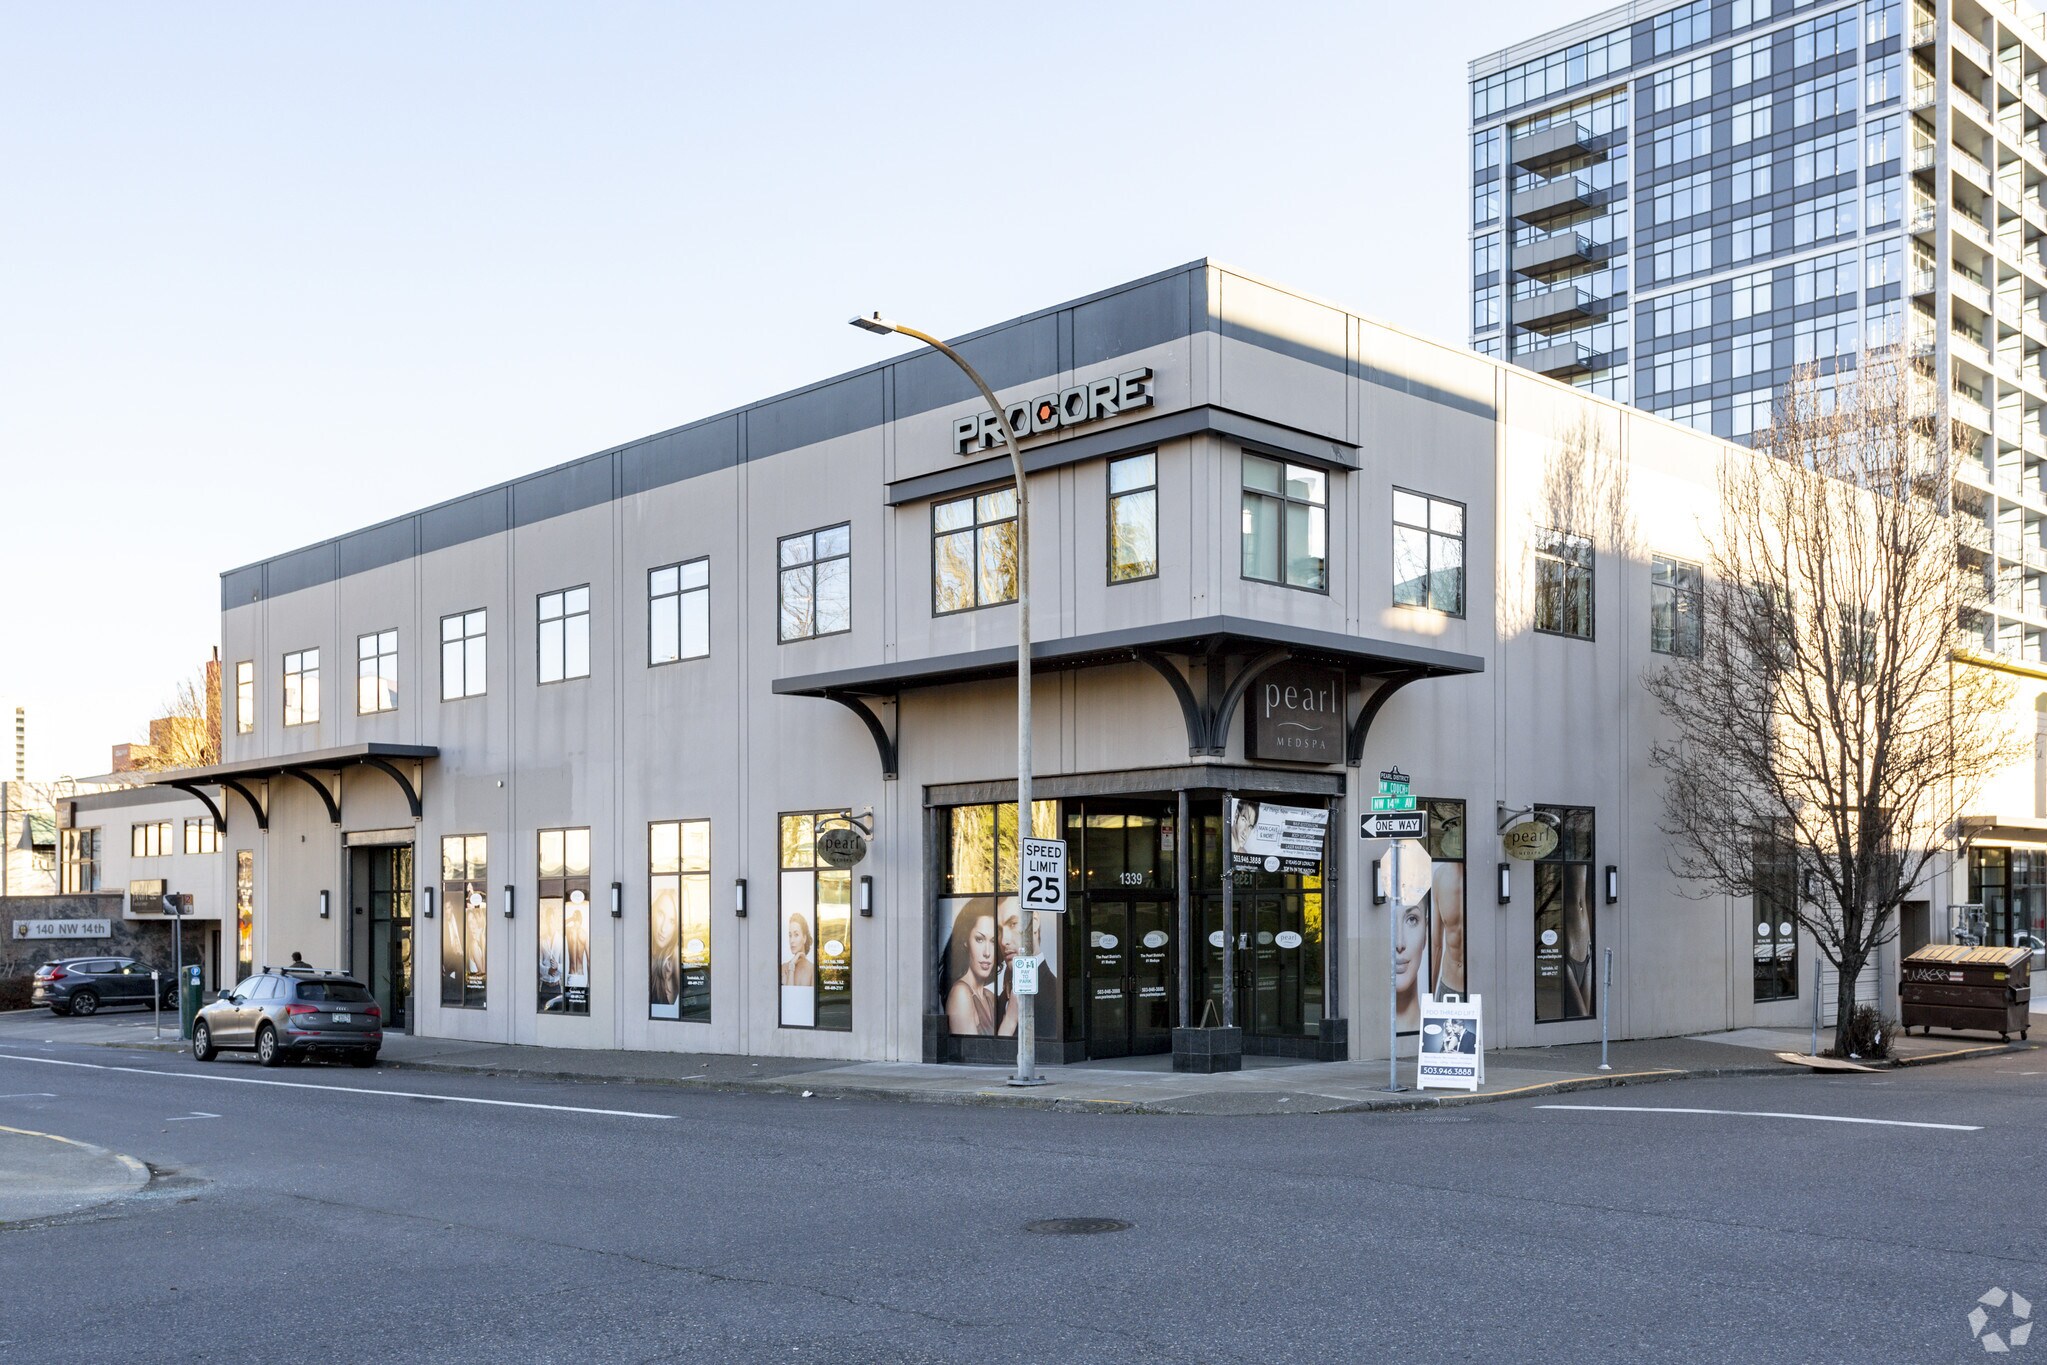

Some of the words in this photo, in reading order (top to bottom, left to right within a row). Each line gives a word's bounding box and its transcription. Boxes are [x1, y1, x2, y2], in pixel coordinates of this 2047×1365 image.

[953, 367, 1154, 456] PROCORE
[1266, 680, 1335, 718] pearl
[1277, 737, 1326, 750] MEDSPA
[1380, 781, 1388, 791] NW
[1390, 783, 1405, 794] COUCH
[1374, 798, 1385, 809] NW
[1405, 797, 1413, 808] AV
[1376, 821, 1394, 831] ONE
[1399, 820, 1418, 830] WAY
[1512, 826, 1550, 846] pearl
[825, 835, 860, 851] pearl
[1026, 844, 1062, 859] SPEED
[1029, 860, 1058, 873] LIMIT
[1119, 872, 1142, 885] 1339
[1026, 875, 1061, 904] 25
[185, 896, 191, 904] 2
[36, 924, 54, 935] 140
[59, 924, 78, 934] NW
[82, 923, 105, 934] 14th
[1280, 934, 1297, 942] pearl
[1423, 1066, 1472, 1076] 503.946.3888
